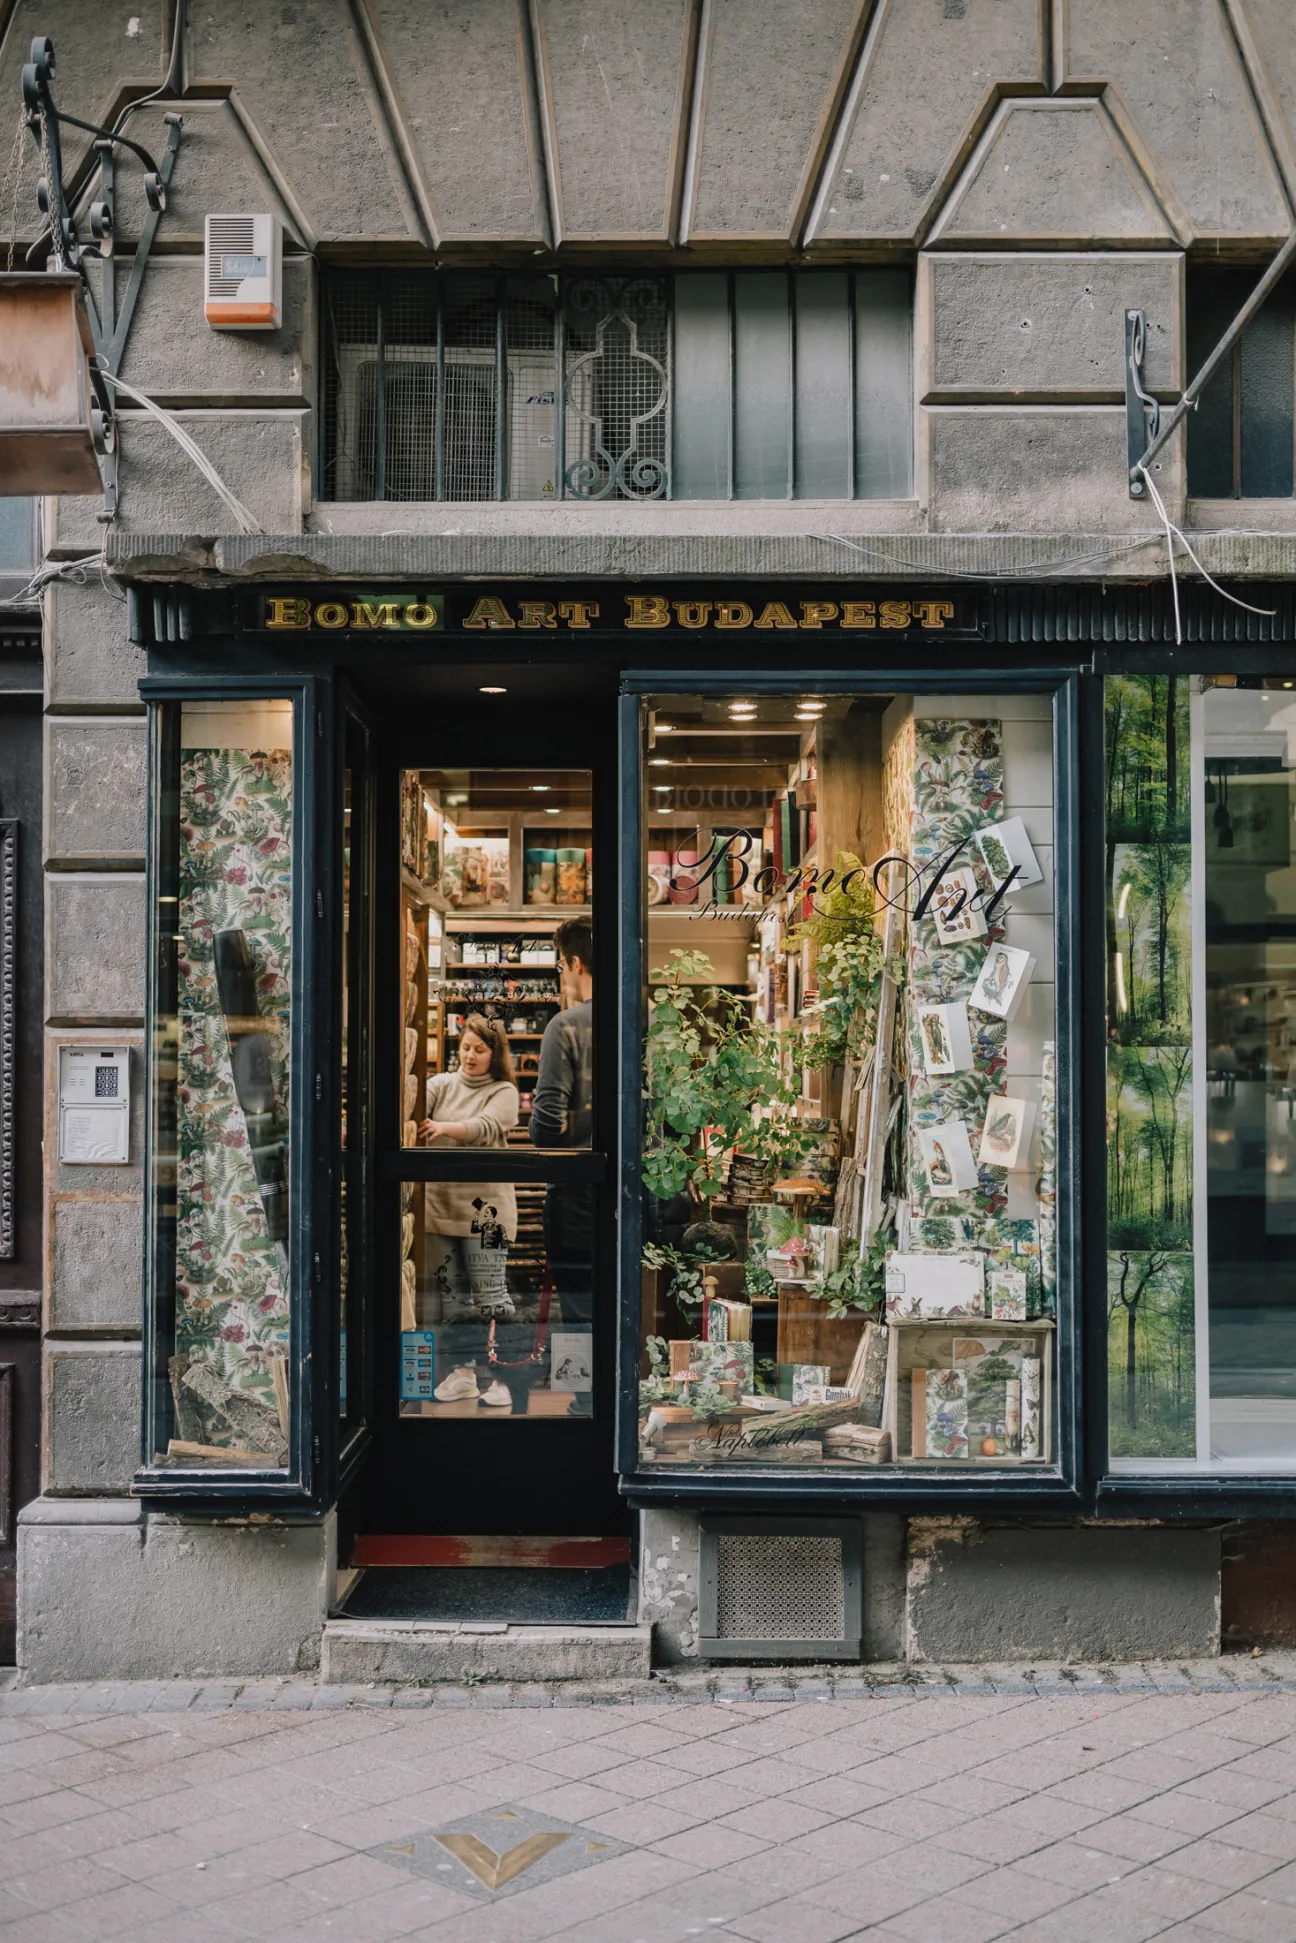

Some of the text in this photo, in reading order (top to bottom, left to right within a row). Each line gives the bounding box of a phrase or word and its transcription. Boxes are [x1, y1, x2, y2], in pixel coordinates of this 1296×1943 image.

[265, 596, 954, 629] BOMO ART BUDAPEST
[807, 836, 1029, 922] Art
[688, 896, 798, 931] Budapest
